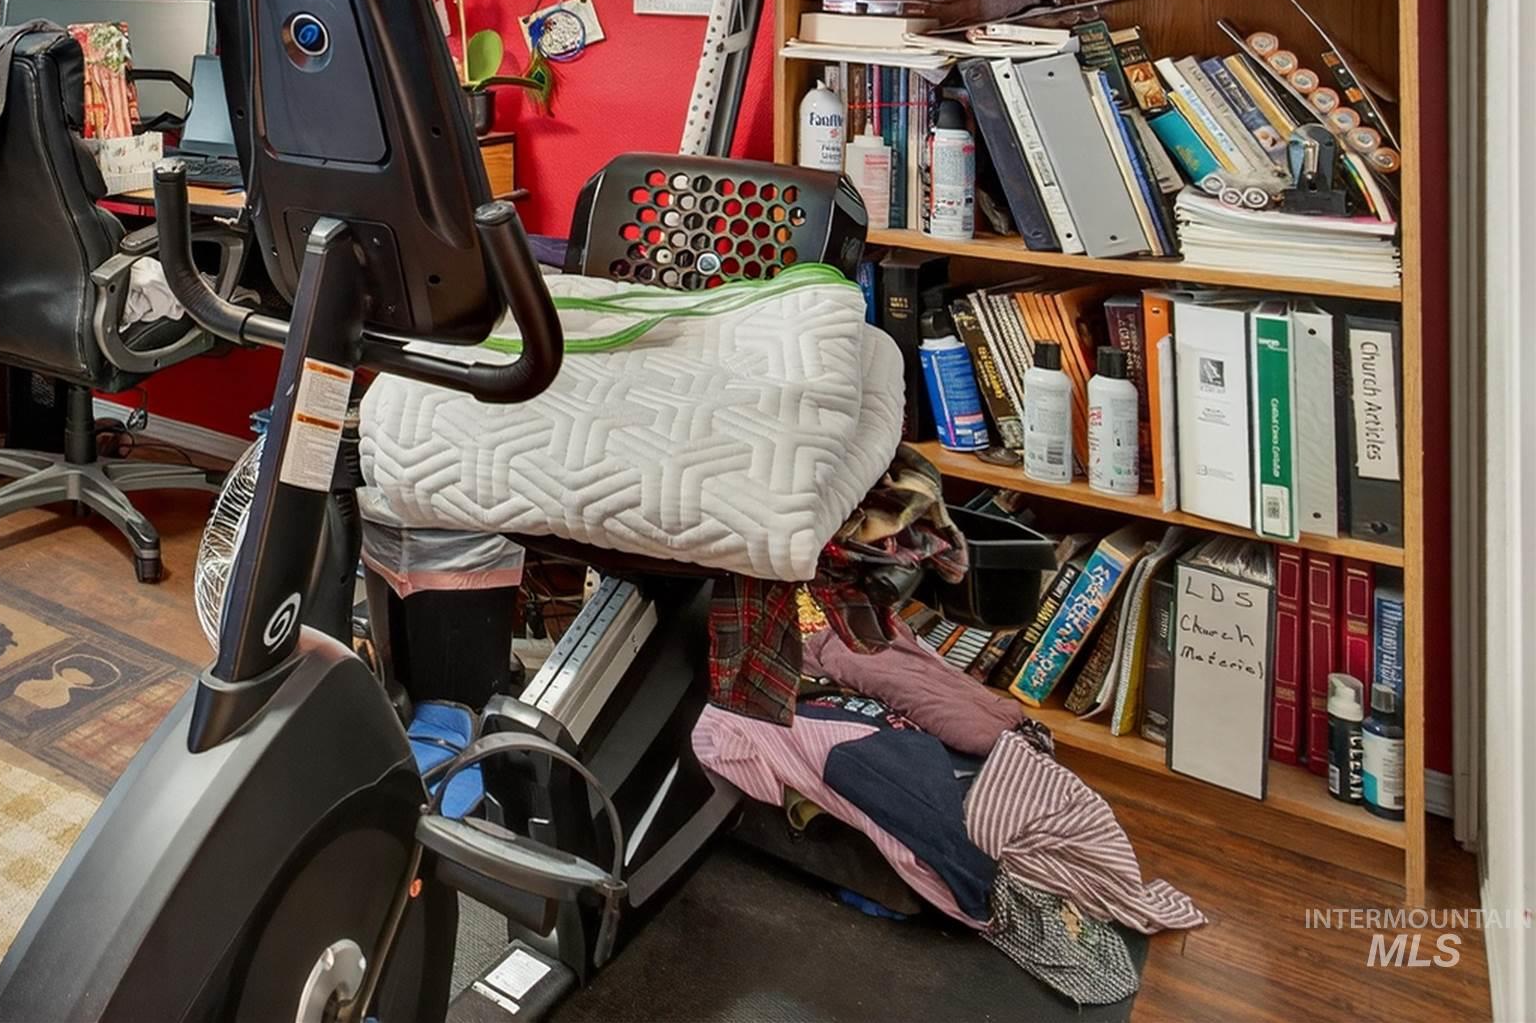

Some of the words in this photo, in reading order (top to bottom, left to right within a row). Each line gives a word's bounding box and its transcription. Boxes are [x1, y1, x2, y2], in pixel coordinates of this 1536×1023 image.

[1359, 340, 1382, 397] Church
[1364, 400, 1386, 462] Articles
[1179, 613, 1256, 648] Church
[1180, 645, 1264, 680] Material
